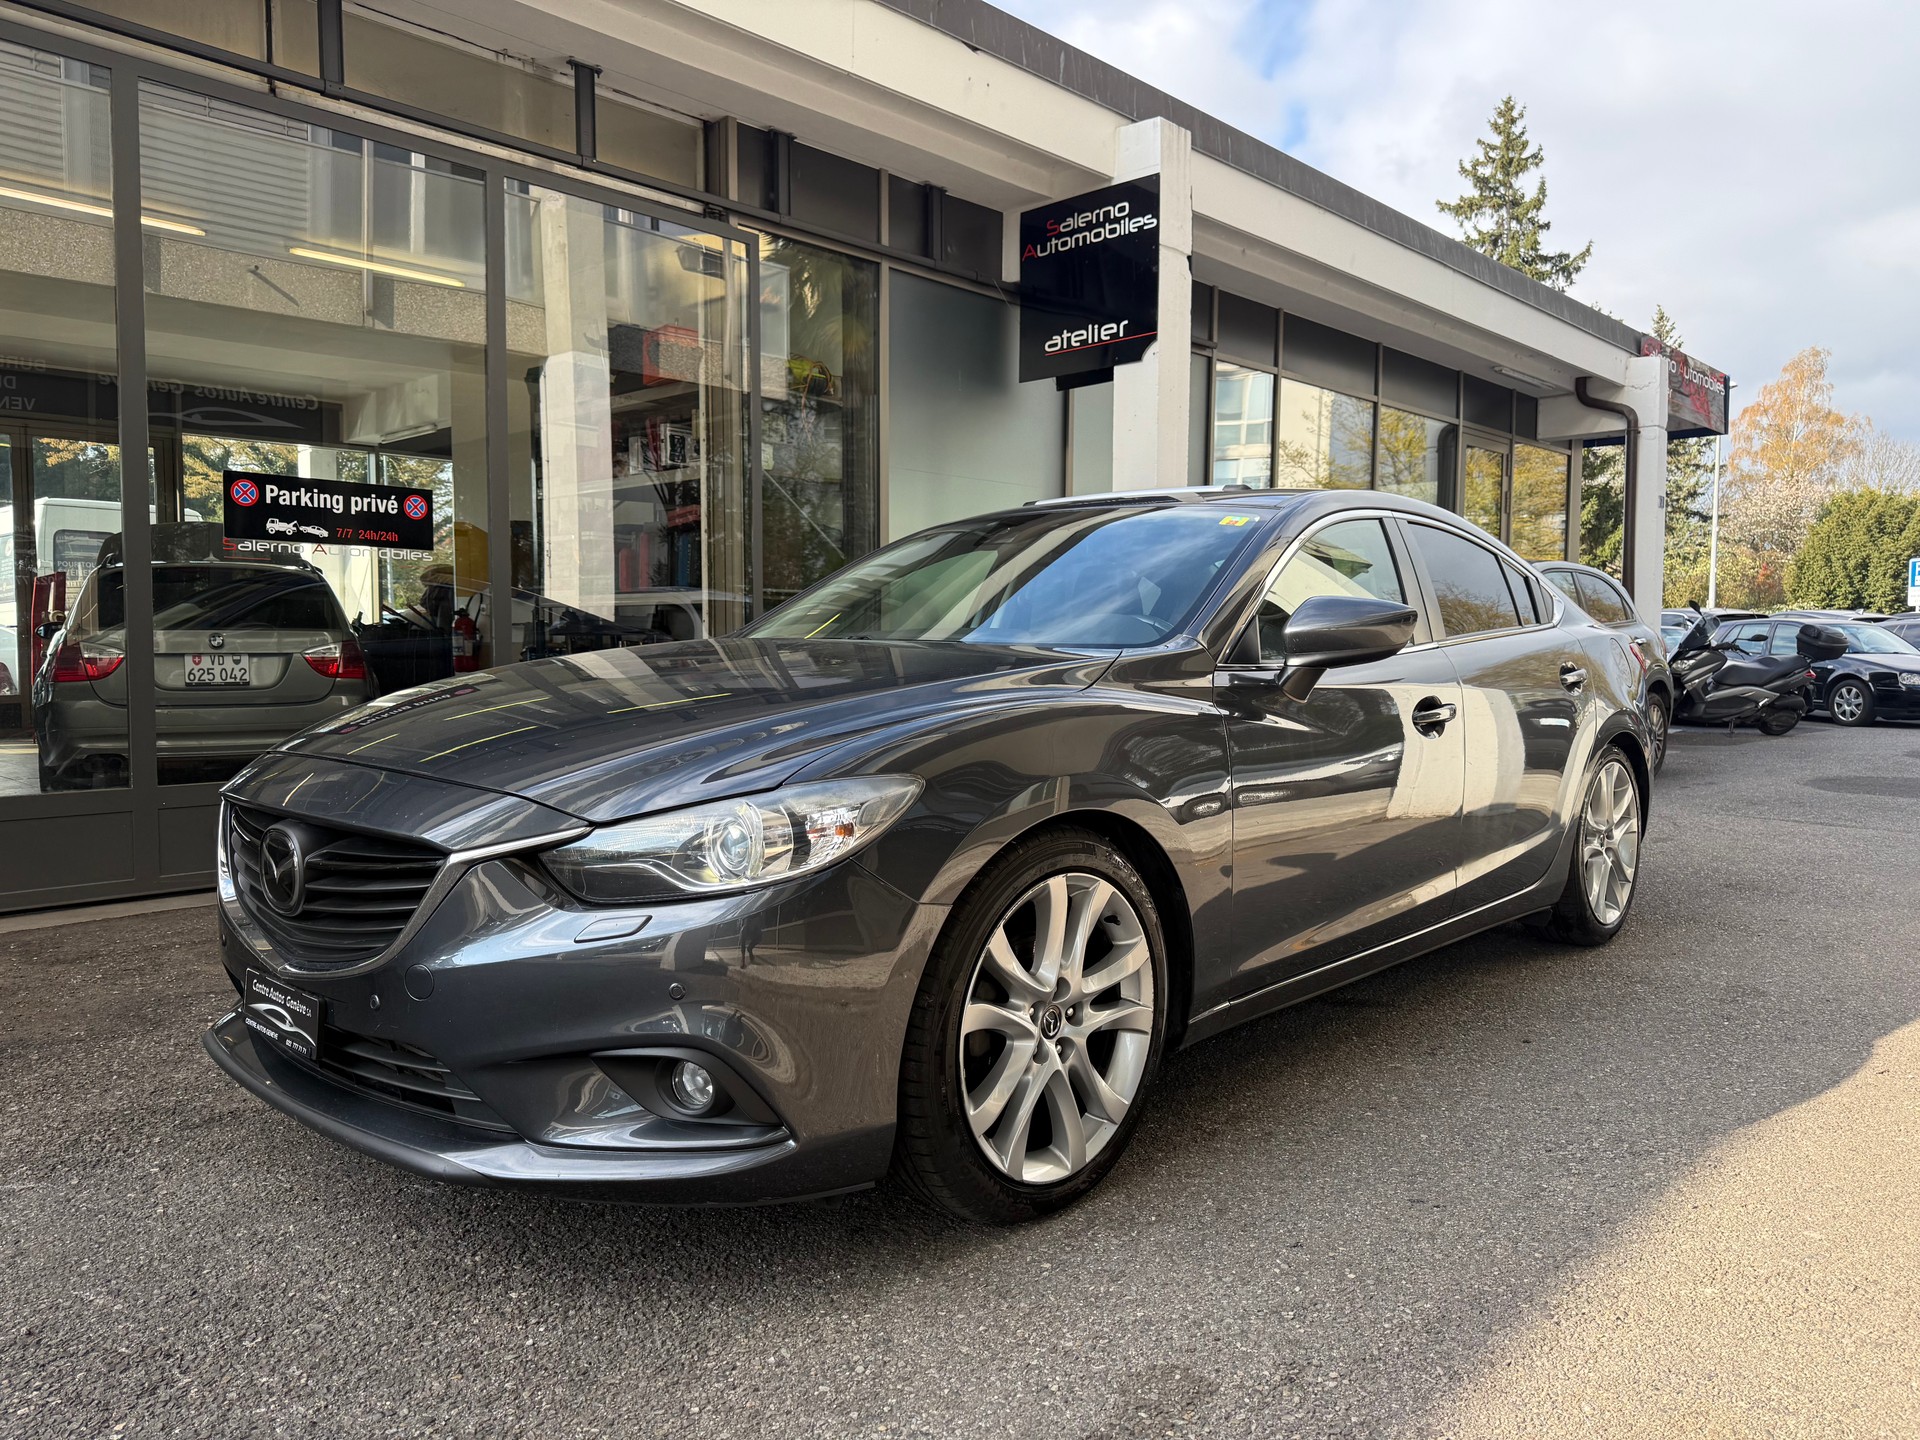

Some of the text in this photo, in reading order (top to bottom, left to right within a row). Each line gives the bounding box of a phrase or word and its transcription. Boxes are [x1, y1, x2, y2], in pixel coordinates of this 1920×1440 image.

[1046, 201, 1129, 236] Salerno
[1022, 213, 1158, 262] Automobiles
[1044, 320, 1128, 352] atelier
[1679, 361, 1725, 396] Automobiles
[265, 484, 398, 515] Parking privé
[223, 538, 304, 554] Salerno
[336, 527, 399, 542] 7/7 24h/24h
[187, 667, 248, 682] 625 042
[209, 654, 225, 666] VD
[252, 979, 270, 997] Centre
[268, 986, 285, 1004] Autos
[286, 995, 307, 1015] Genève
